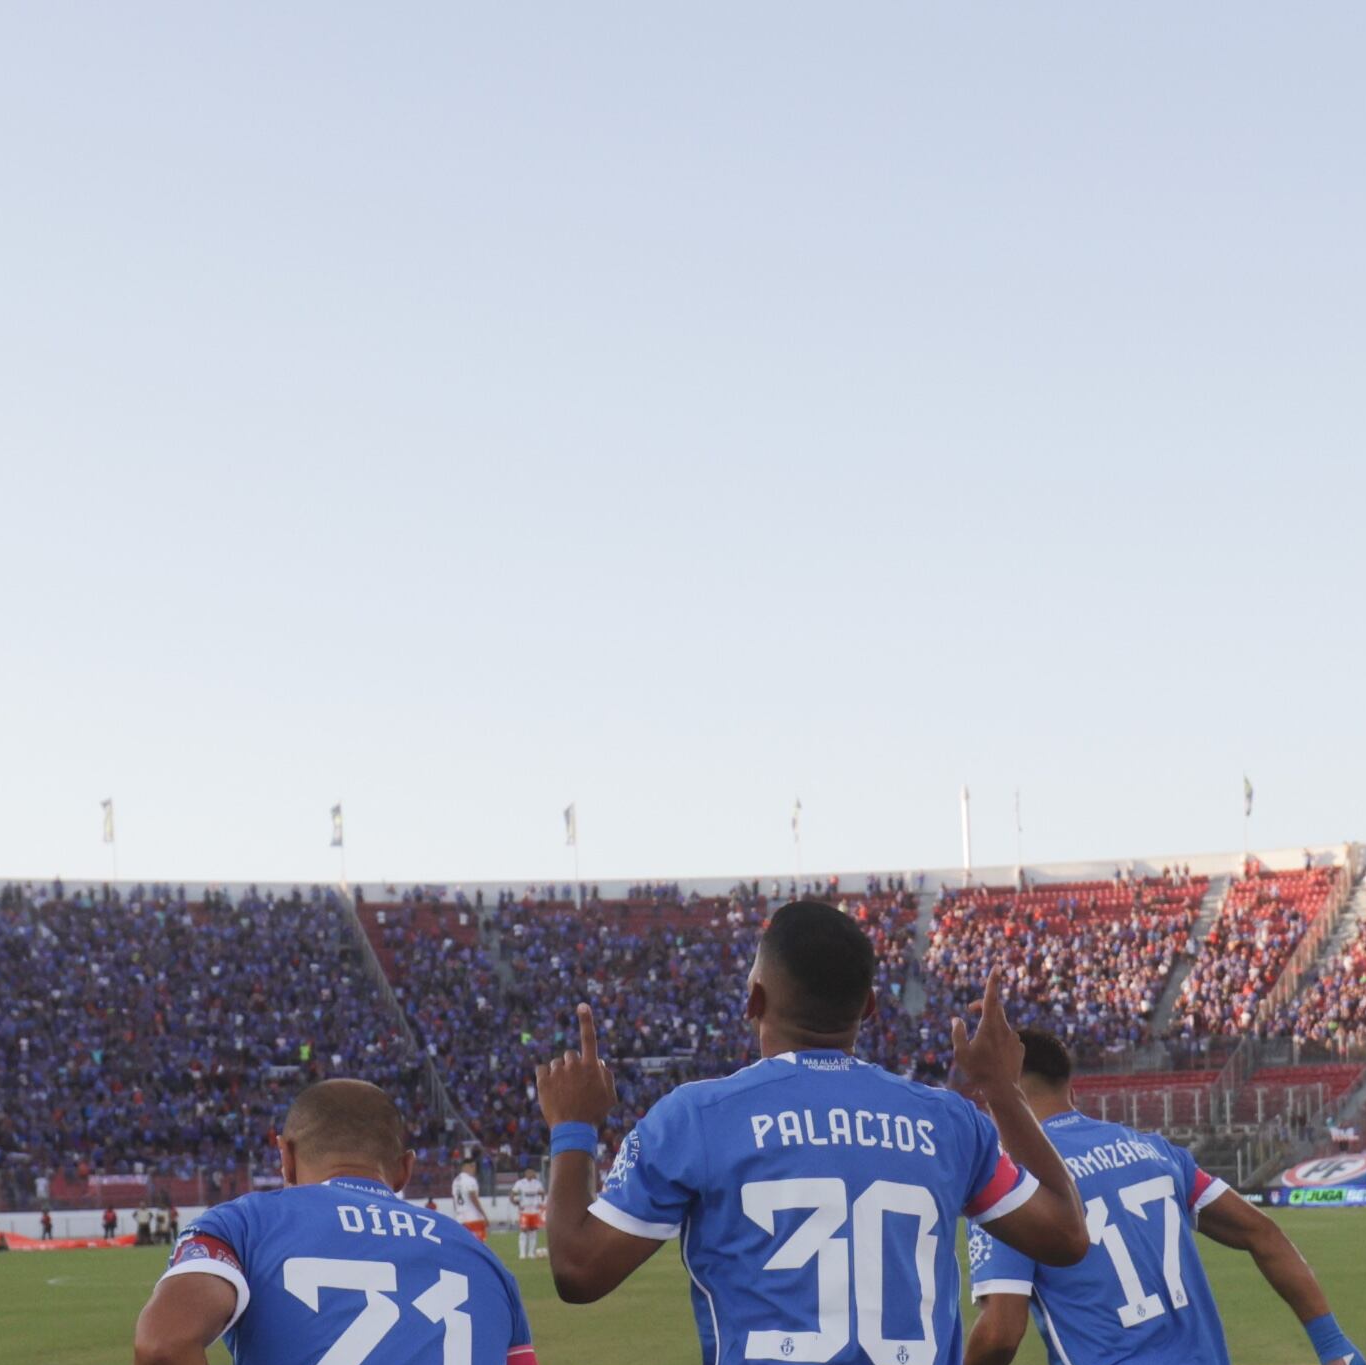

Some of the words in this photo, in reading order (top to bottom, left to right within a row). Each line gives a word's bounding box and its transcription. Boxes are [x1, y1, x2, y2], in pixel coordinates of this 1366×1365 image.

[751, 1108, 936, 1156] PALACIOS
[337, 1204, 442, 1244] DÍAZ
[1085, 1176, 1188, 1328] 17
